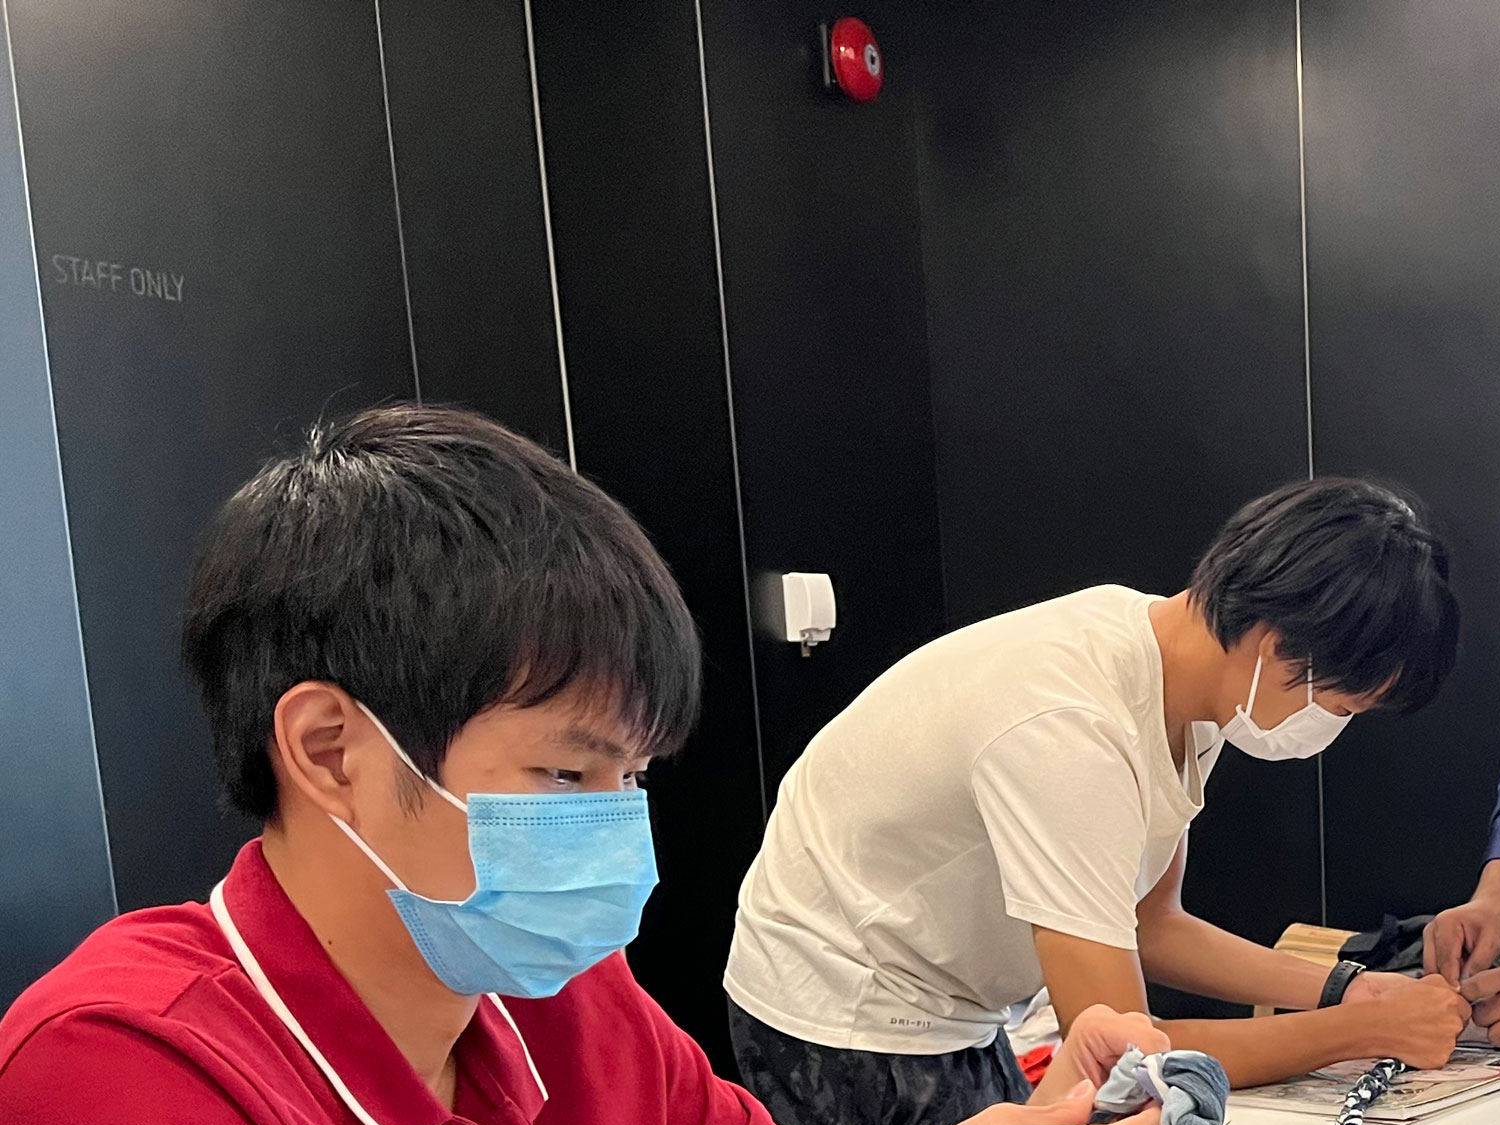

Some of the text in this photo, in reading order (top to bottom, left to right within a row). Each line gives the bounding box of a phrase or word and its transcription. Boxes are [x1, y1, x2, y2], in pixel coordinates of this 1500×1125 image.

[53, 254, 184, 302] STAFF ONLY
[890, 1017, 931, 1028] DRI-FIT
